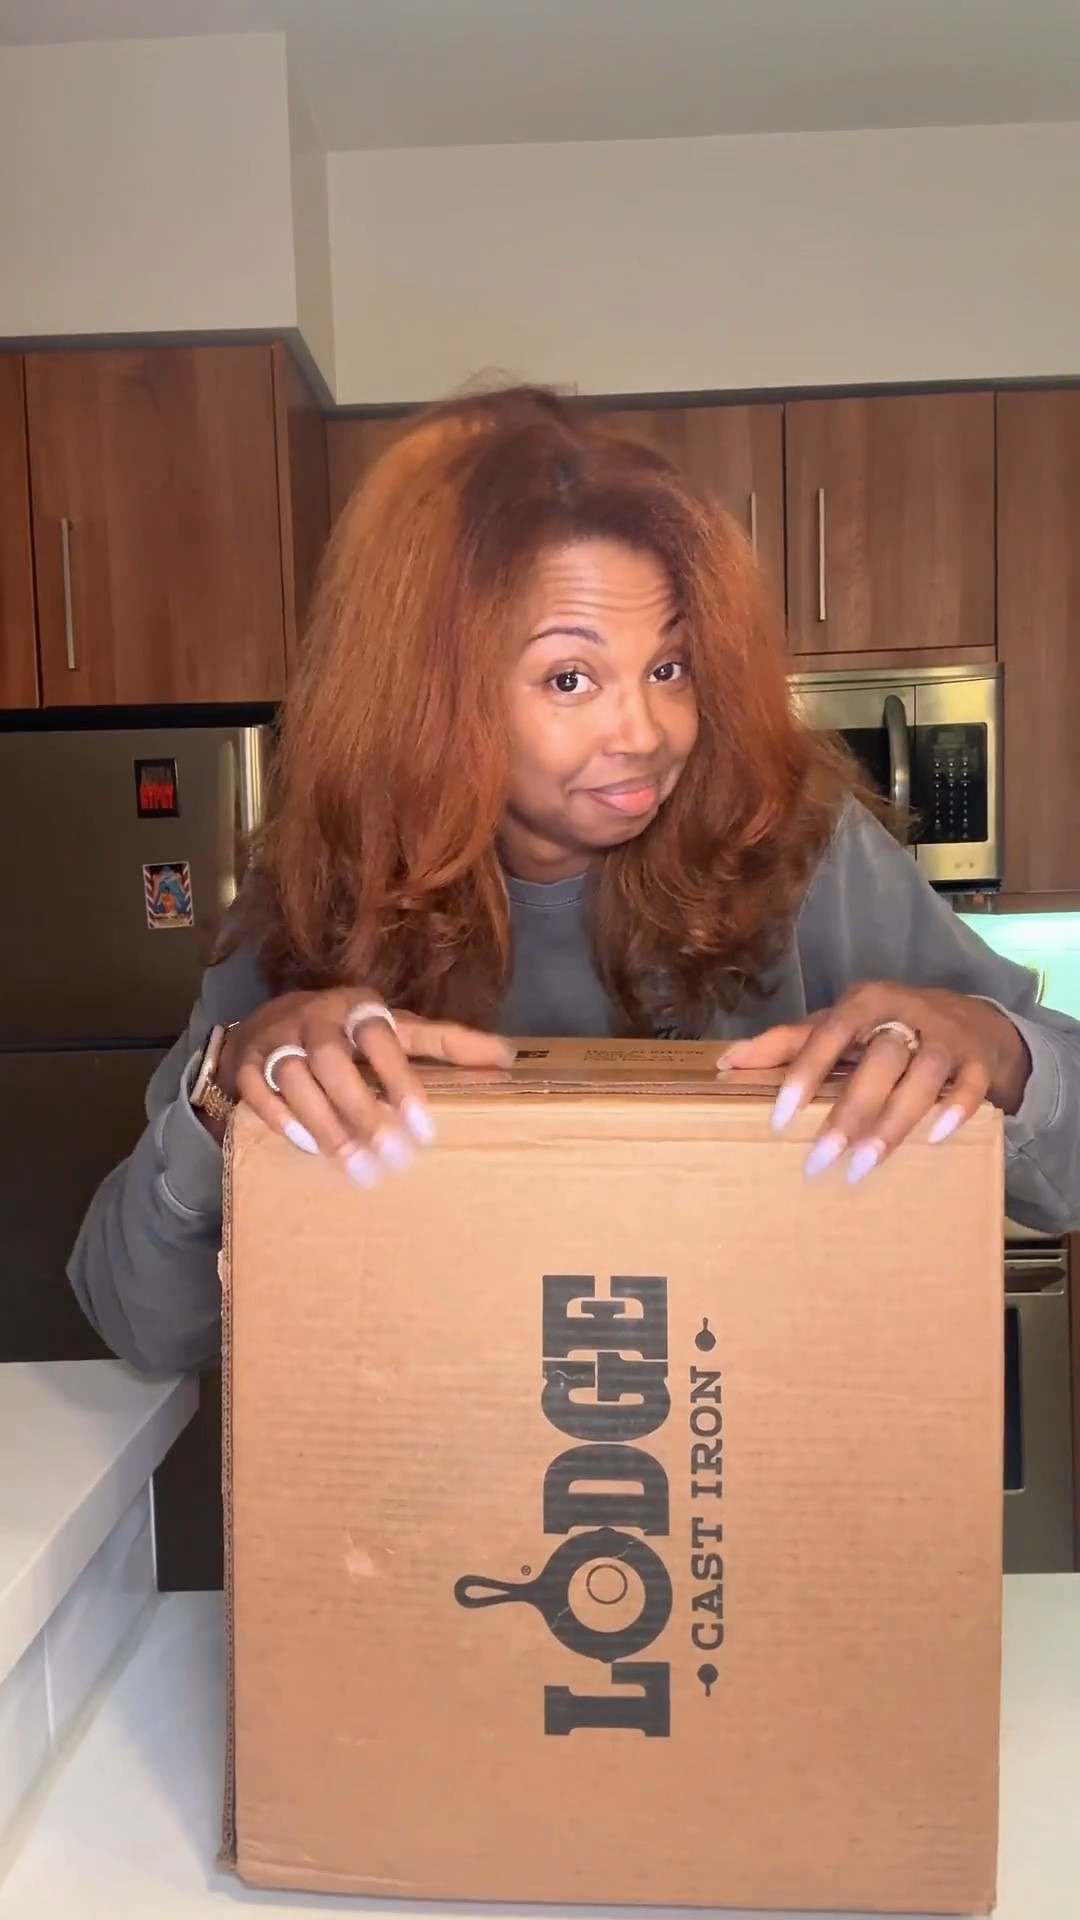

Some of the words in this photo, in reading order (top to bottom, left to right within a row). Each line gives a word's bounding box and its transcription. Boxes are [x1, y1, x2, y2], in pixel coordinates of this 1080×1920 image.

[689, 1366, 723, 1499] IRON
[541, 1275, 673, 1738] LODGE
[690, 1517, 724, 1651] CAST
